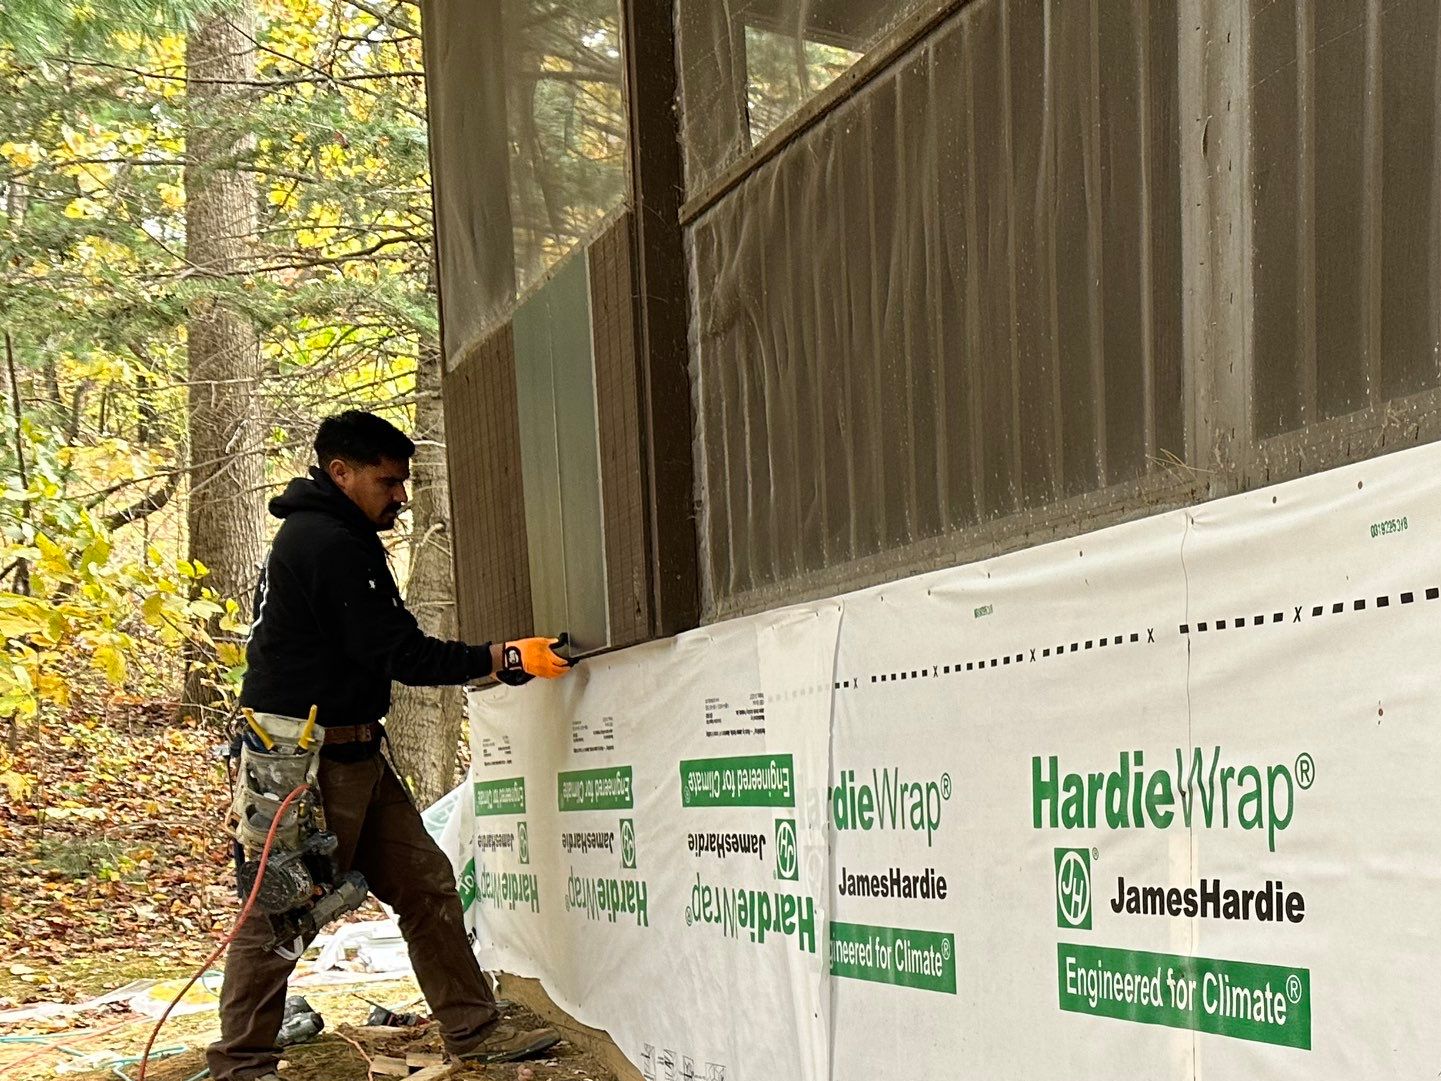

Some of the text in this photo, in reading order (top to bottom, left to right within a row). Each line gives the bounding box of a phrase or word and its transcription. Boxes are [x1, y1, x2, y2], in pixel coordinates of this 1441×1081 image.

[722, 771, 735, 798] for
[736, 760, 790, 798] Engineered
[1031, 745, 1316, 853] HardieWrap®
[562, 832, 615, 854] JamesHardie
[688, 833, 766, 860] JamesHardie
[838, 867, 947, 900] JamesHardie
[1110, 876, 1306, 924] JamesHardie
[875, 936, 892, 970] for
[1065, 956, 1163, 1008] Engineered
[1166, 967, 1198, 1012] for
